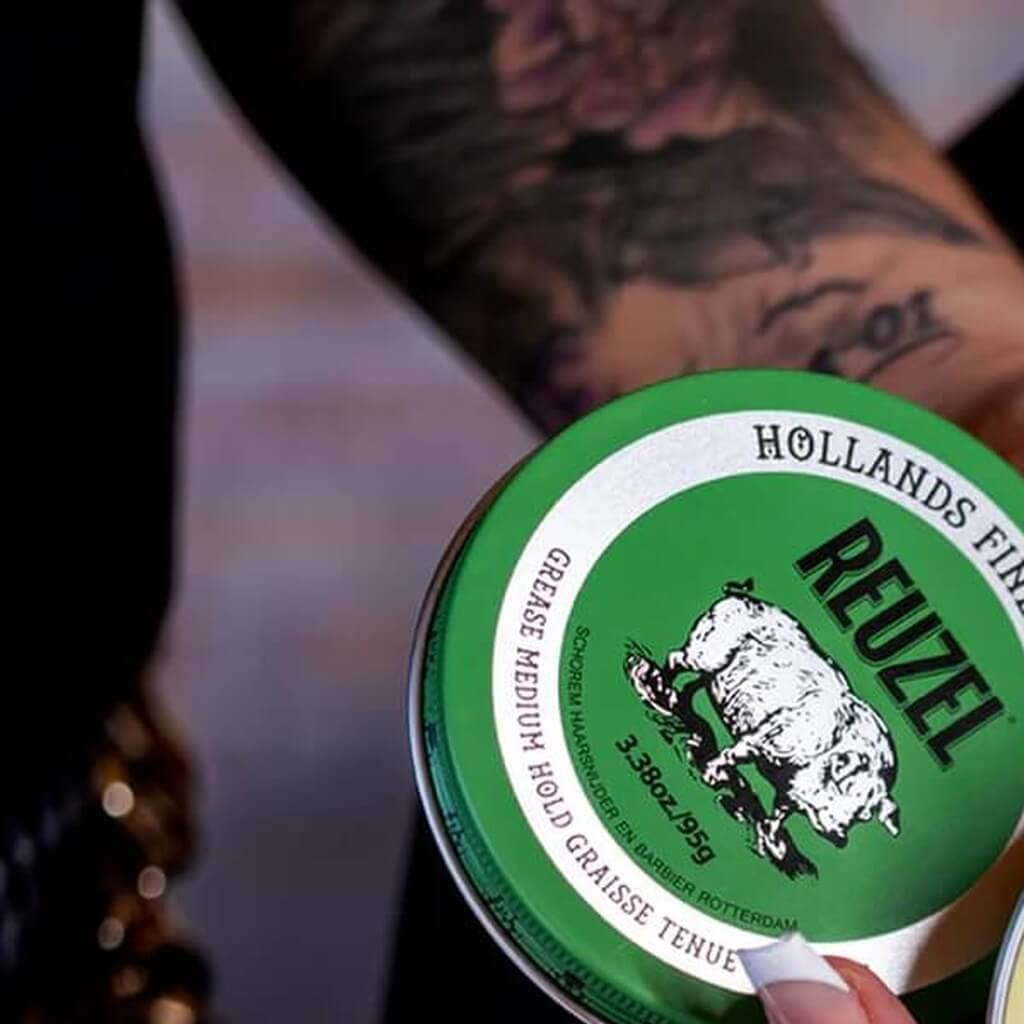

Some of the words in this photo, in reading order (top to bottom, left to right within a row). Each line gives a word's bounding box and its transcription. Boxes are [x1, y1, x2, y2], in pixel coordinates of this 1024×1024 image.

[753, 424, 977, 529] HOLLANDS
[519, 547, 571, 641] GREASE
[567, 625, 590, 706] SCHOREM
[792, 517, 1005, 772] REUZEL
[514, 646, 545, 752] MEDIUM
[528, 761, 573, 829] HOLD
[570, 710, 620, 820] HAARSNIJDER
[614, 820, 637, 844] EN
[634, 842, 697, 897] BARBIER
[565, 833, 655, 926] GRAISSE
[697, 889, 799, 931] ROTTERDAM
[658, 916, 738, 973] TENUE
